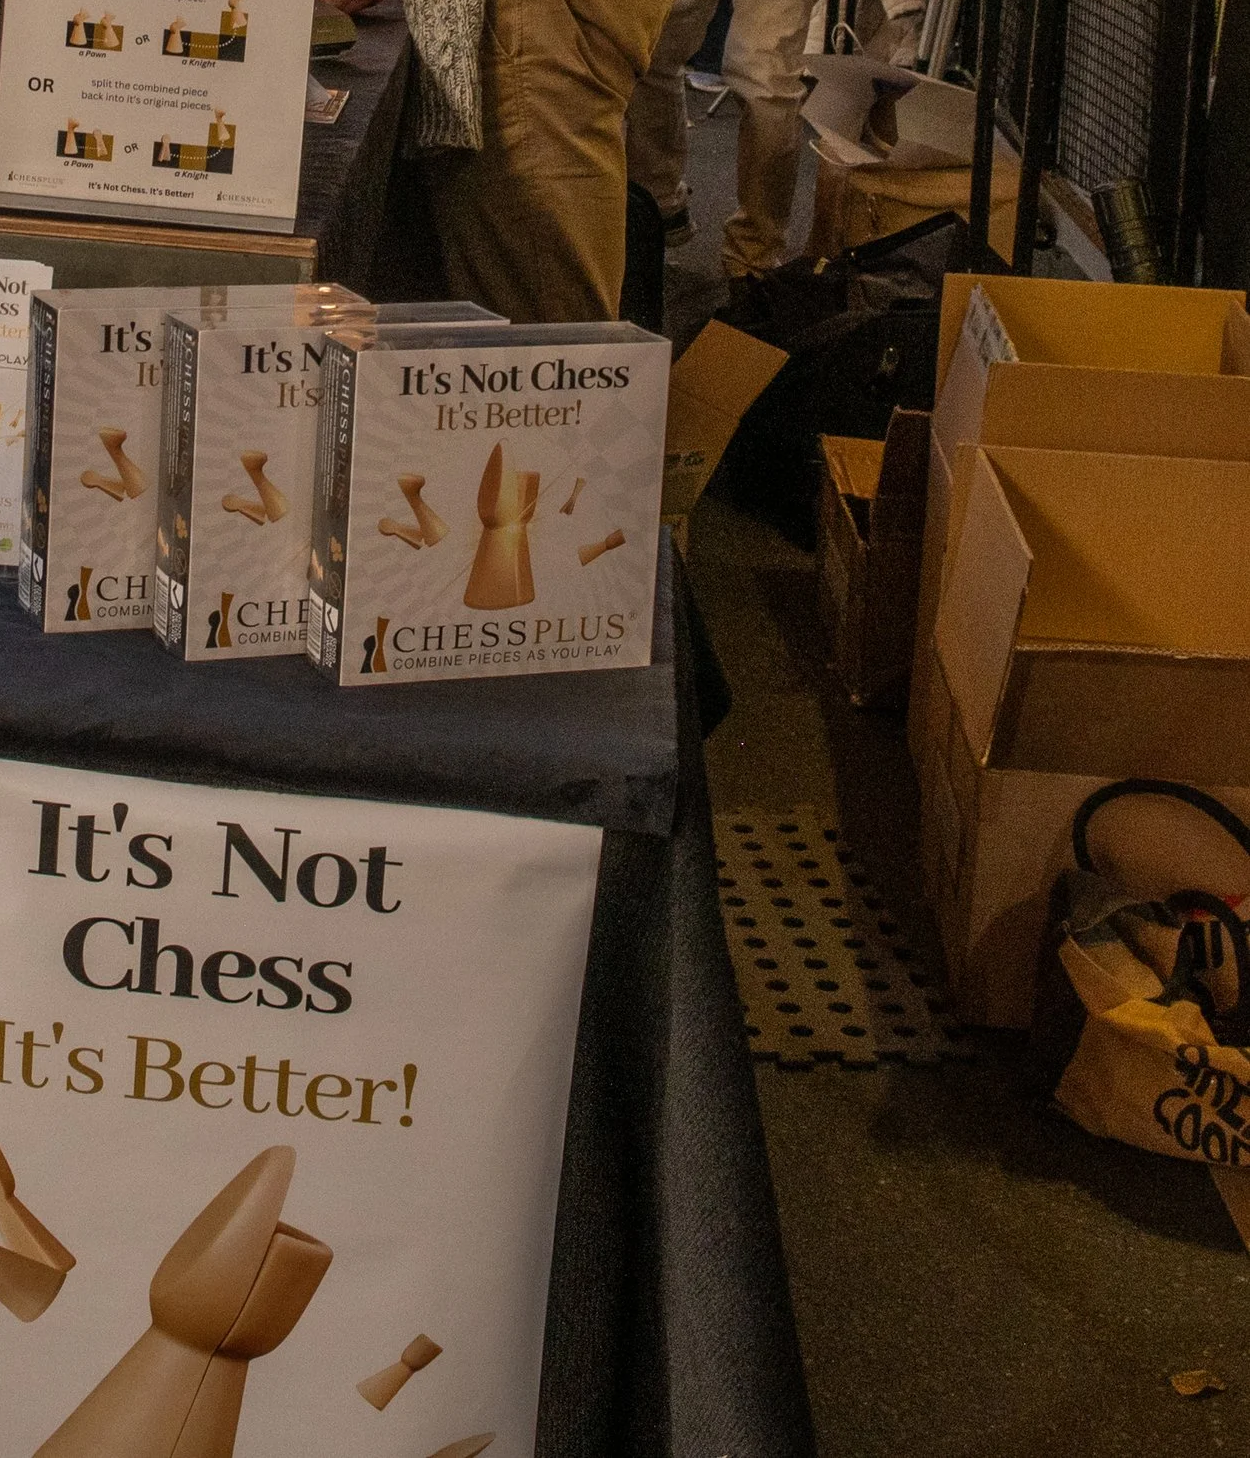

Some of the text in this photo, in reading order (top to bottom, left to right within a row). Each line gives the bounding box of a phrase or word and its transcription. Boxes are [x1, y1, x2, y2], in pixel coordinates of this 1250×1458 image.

[28, 77, 54, 93] OR
[92, 79, 208, 97] split the combined piece
[82, 91, 213, 112] back into it's original pieces.
[88, 182, 194, 199] It's Not Chess. It's Better!
[399, 359, 630, 395] It's Not Chess
[435, 400, 581, 430] It's Better!
[393, 644, 621, 670] COMBINE PIECES AS YOU PLAY
[28, 800, 403, 913] It's Not
[62, 915, 354, 1014] Chess
[124, 1035, 418, 1128] Better!
